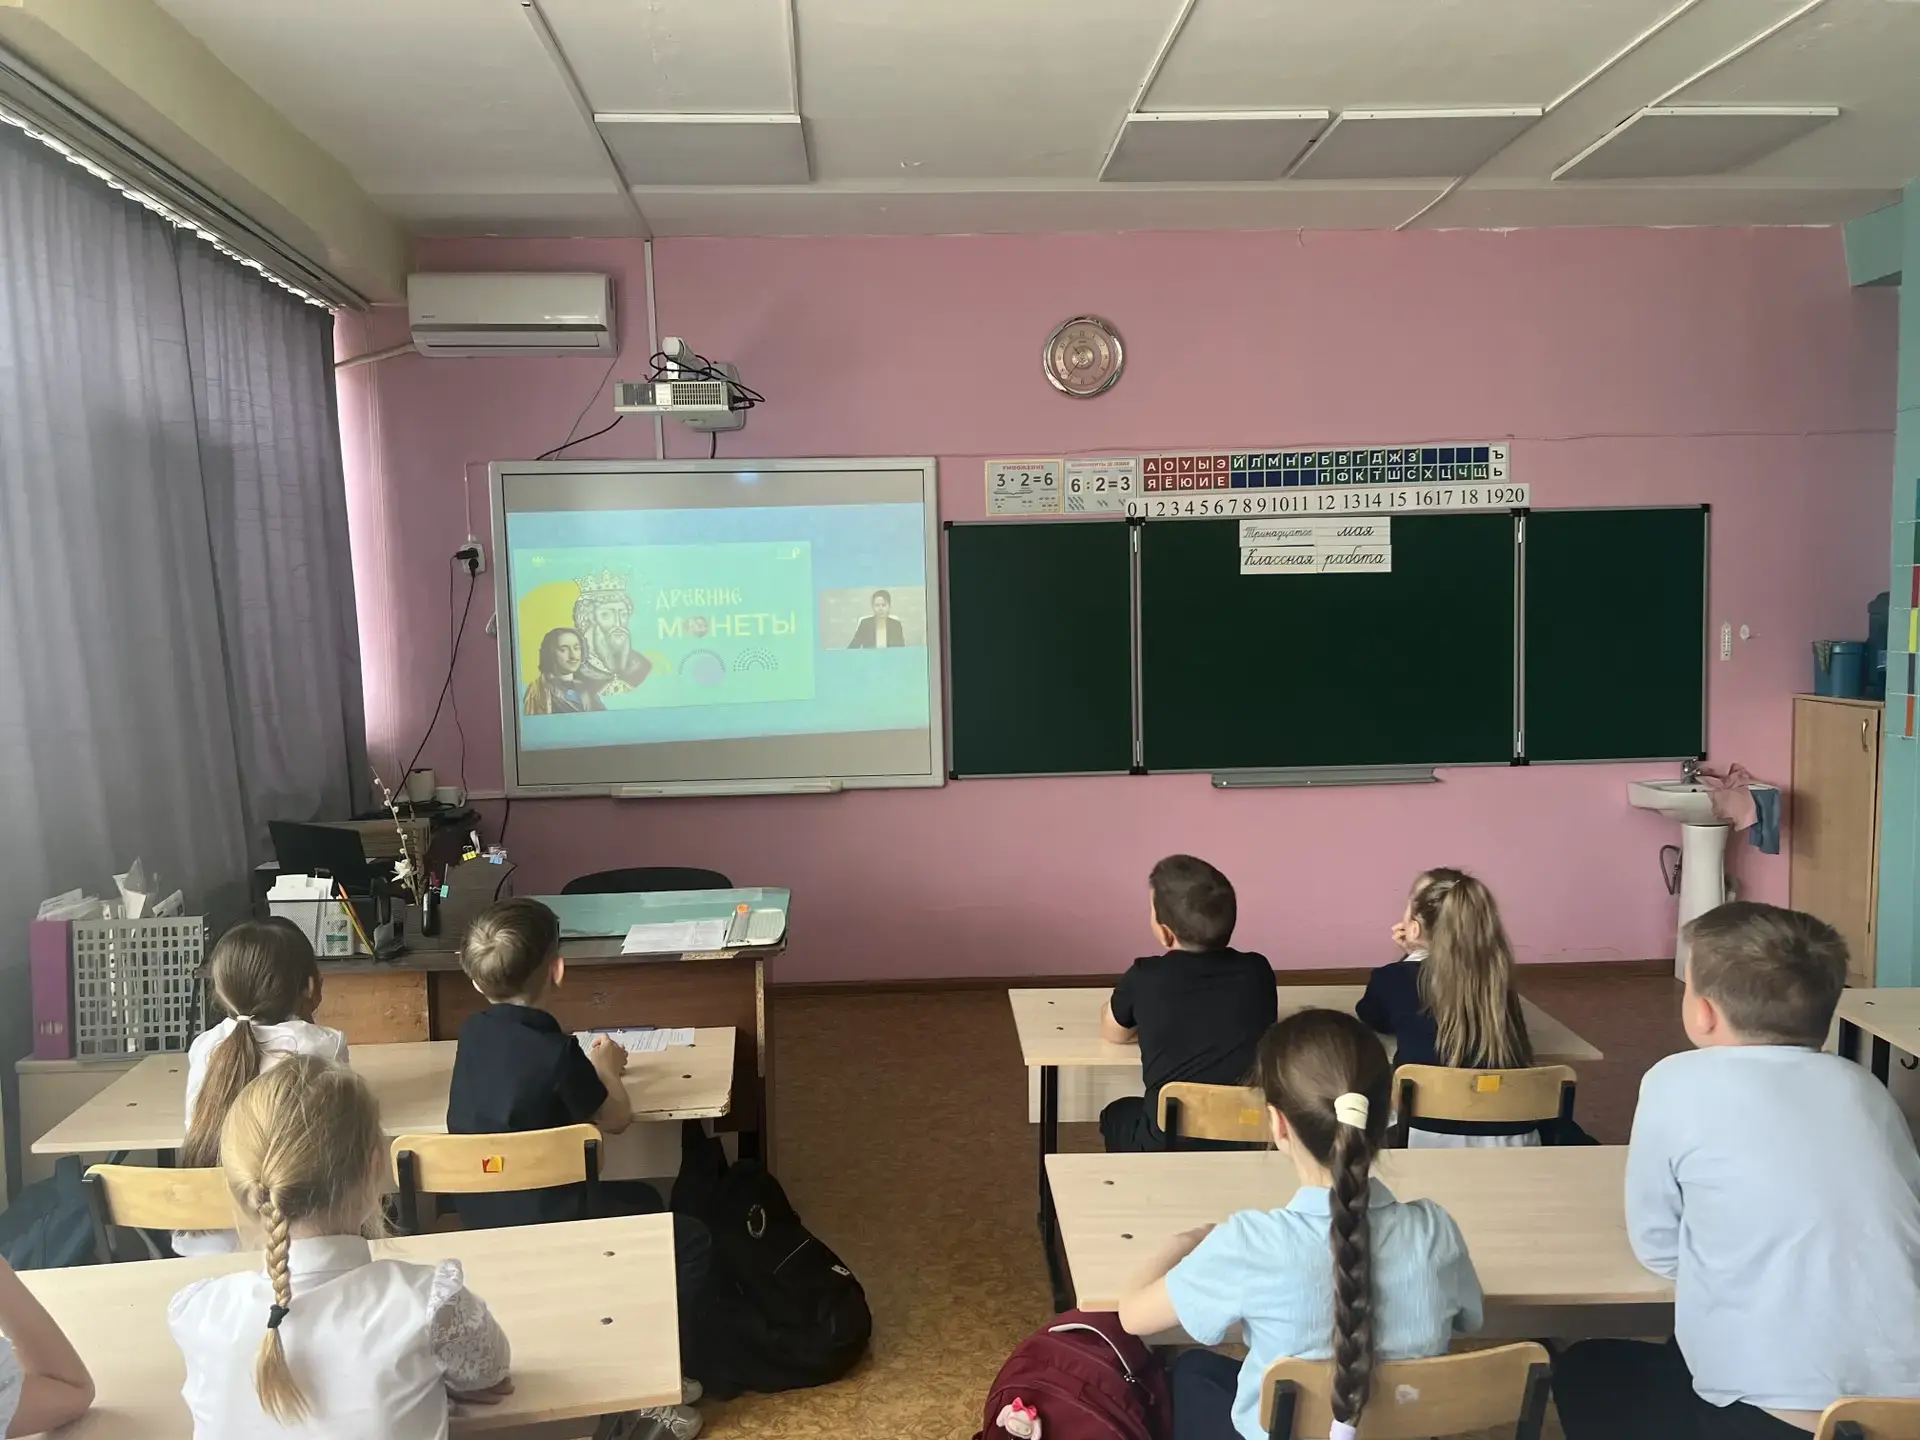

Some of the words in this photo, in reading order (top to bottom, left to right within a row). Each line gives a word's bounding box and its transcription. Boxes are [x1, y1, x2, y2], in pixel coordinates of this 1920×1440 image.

[1146, 462, 1156, 472] А
[1164, 461, 1174, 471] О
[1182, 460, 1191, 470] У
[1198, 460, 1210, 470] Ы
[1216, 459, 1226, 469] Э
[1233, 456, 1244, 468] Й
[1250, 458, 1261, 468] Л
[1268, 458, 1279, 467] М
[1286, 456, 1296, 466] Н
[1304, 456, 1312, 466] Р
[1321, 456, 1330, 465] Б
[1338, 455, 1347, 464] В
[1356, 454, 1364, 464] Г
[1372, 454, 1383, 464] Д
[1388, 453, 1401, 462] Ж
[1408, 452, 1416, 462] З
[1492, 450, 1504, 460] Ъ
[1127, 502, 1137, 516] 0
[1144, 502, 1150, 516] 1
[1156, 502, 1166, 516] 2
[1170, 501, 1180, 516] 3
[1184, 500, 1195, 516] 4
[1200, 500, 1209, 515] 5
[1214, 500, 1224, 514] 6
[1228, 499, 1238, 514] 7
[1242, 498, 1252, 514] 8
[1256, 498, 1267, 513] 9
[1318, 495, 1336, 510] 12
[1344, 494, 1361, 510] 13
[1364, 492, 1382, 508] 14
[1390, 492, 1407, 508] 15
[1416, 490, 1433, 506] 16
[1436, 490, 1453, 506] 17
[1461, 489, 1478, 504] 18
[1337, 526, 1374, 536] мая
[1244, 548, 1314, 566] Классная
[1322, 545, 1386, 572] работа
[656, 588, 742, 611] ДРЕВНИЕ
